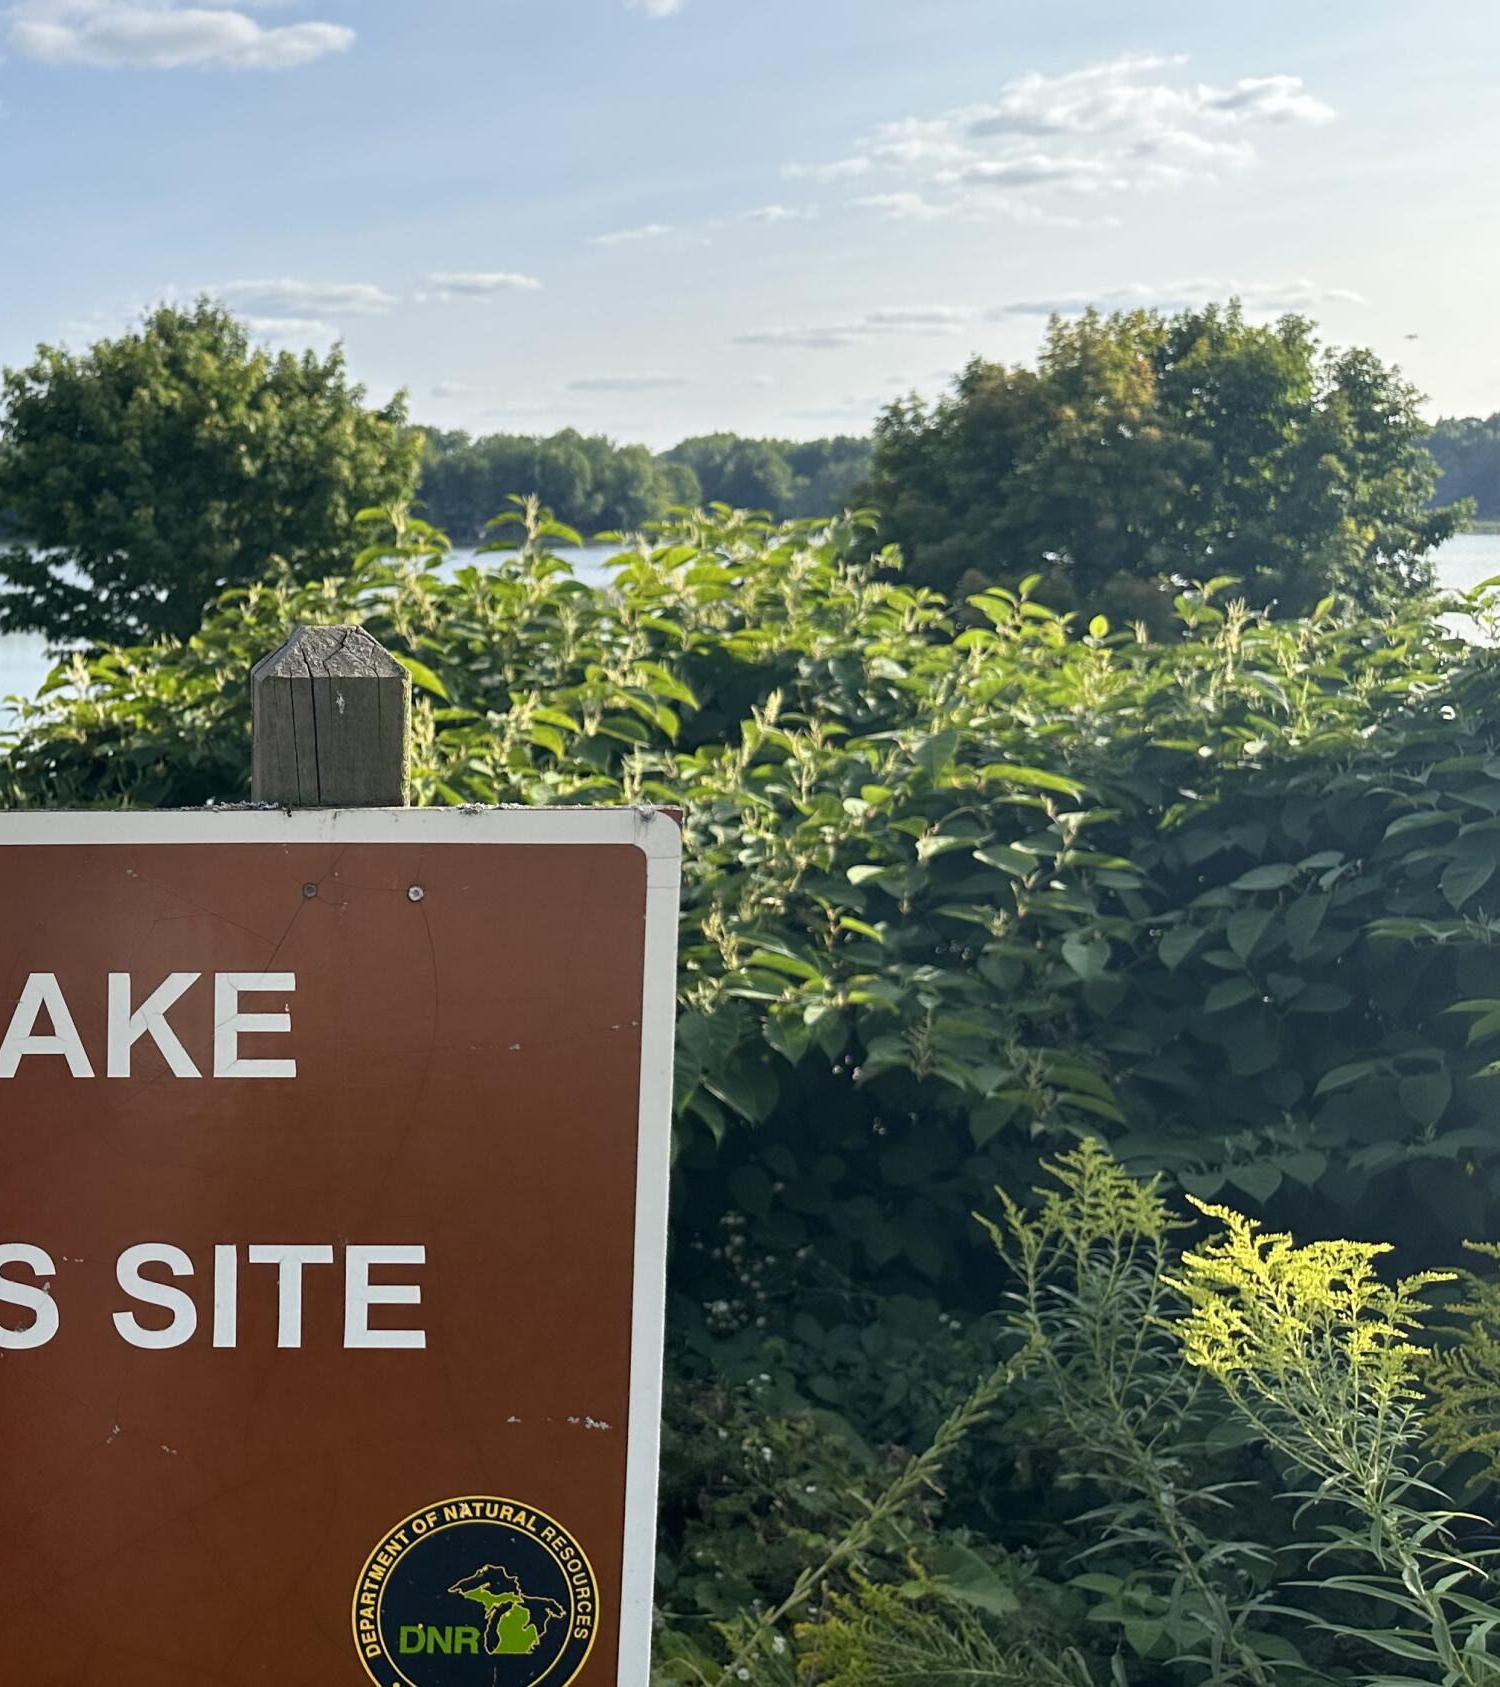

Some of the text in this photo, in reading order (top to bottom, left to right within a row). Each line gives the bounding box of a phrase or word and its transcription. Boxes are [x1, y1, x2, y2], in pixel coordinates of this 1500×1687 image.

[112, 1242, 427, 1350] SITE
[359, 1502, 593, 1660] DEPARTMENT OF NATURAL RESOURCES
[399, 1625, 481, 1655] DNR
